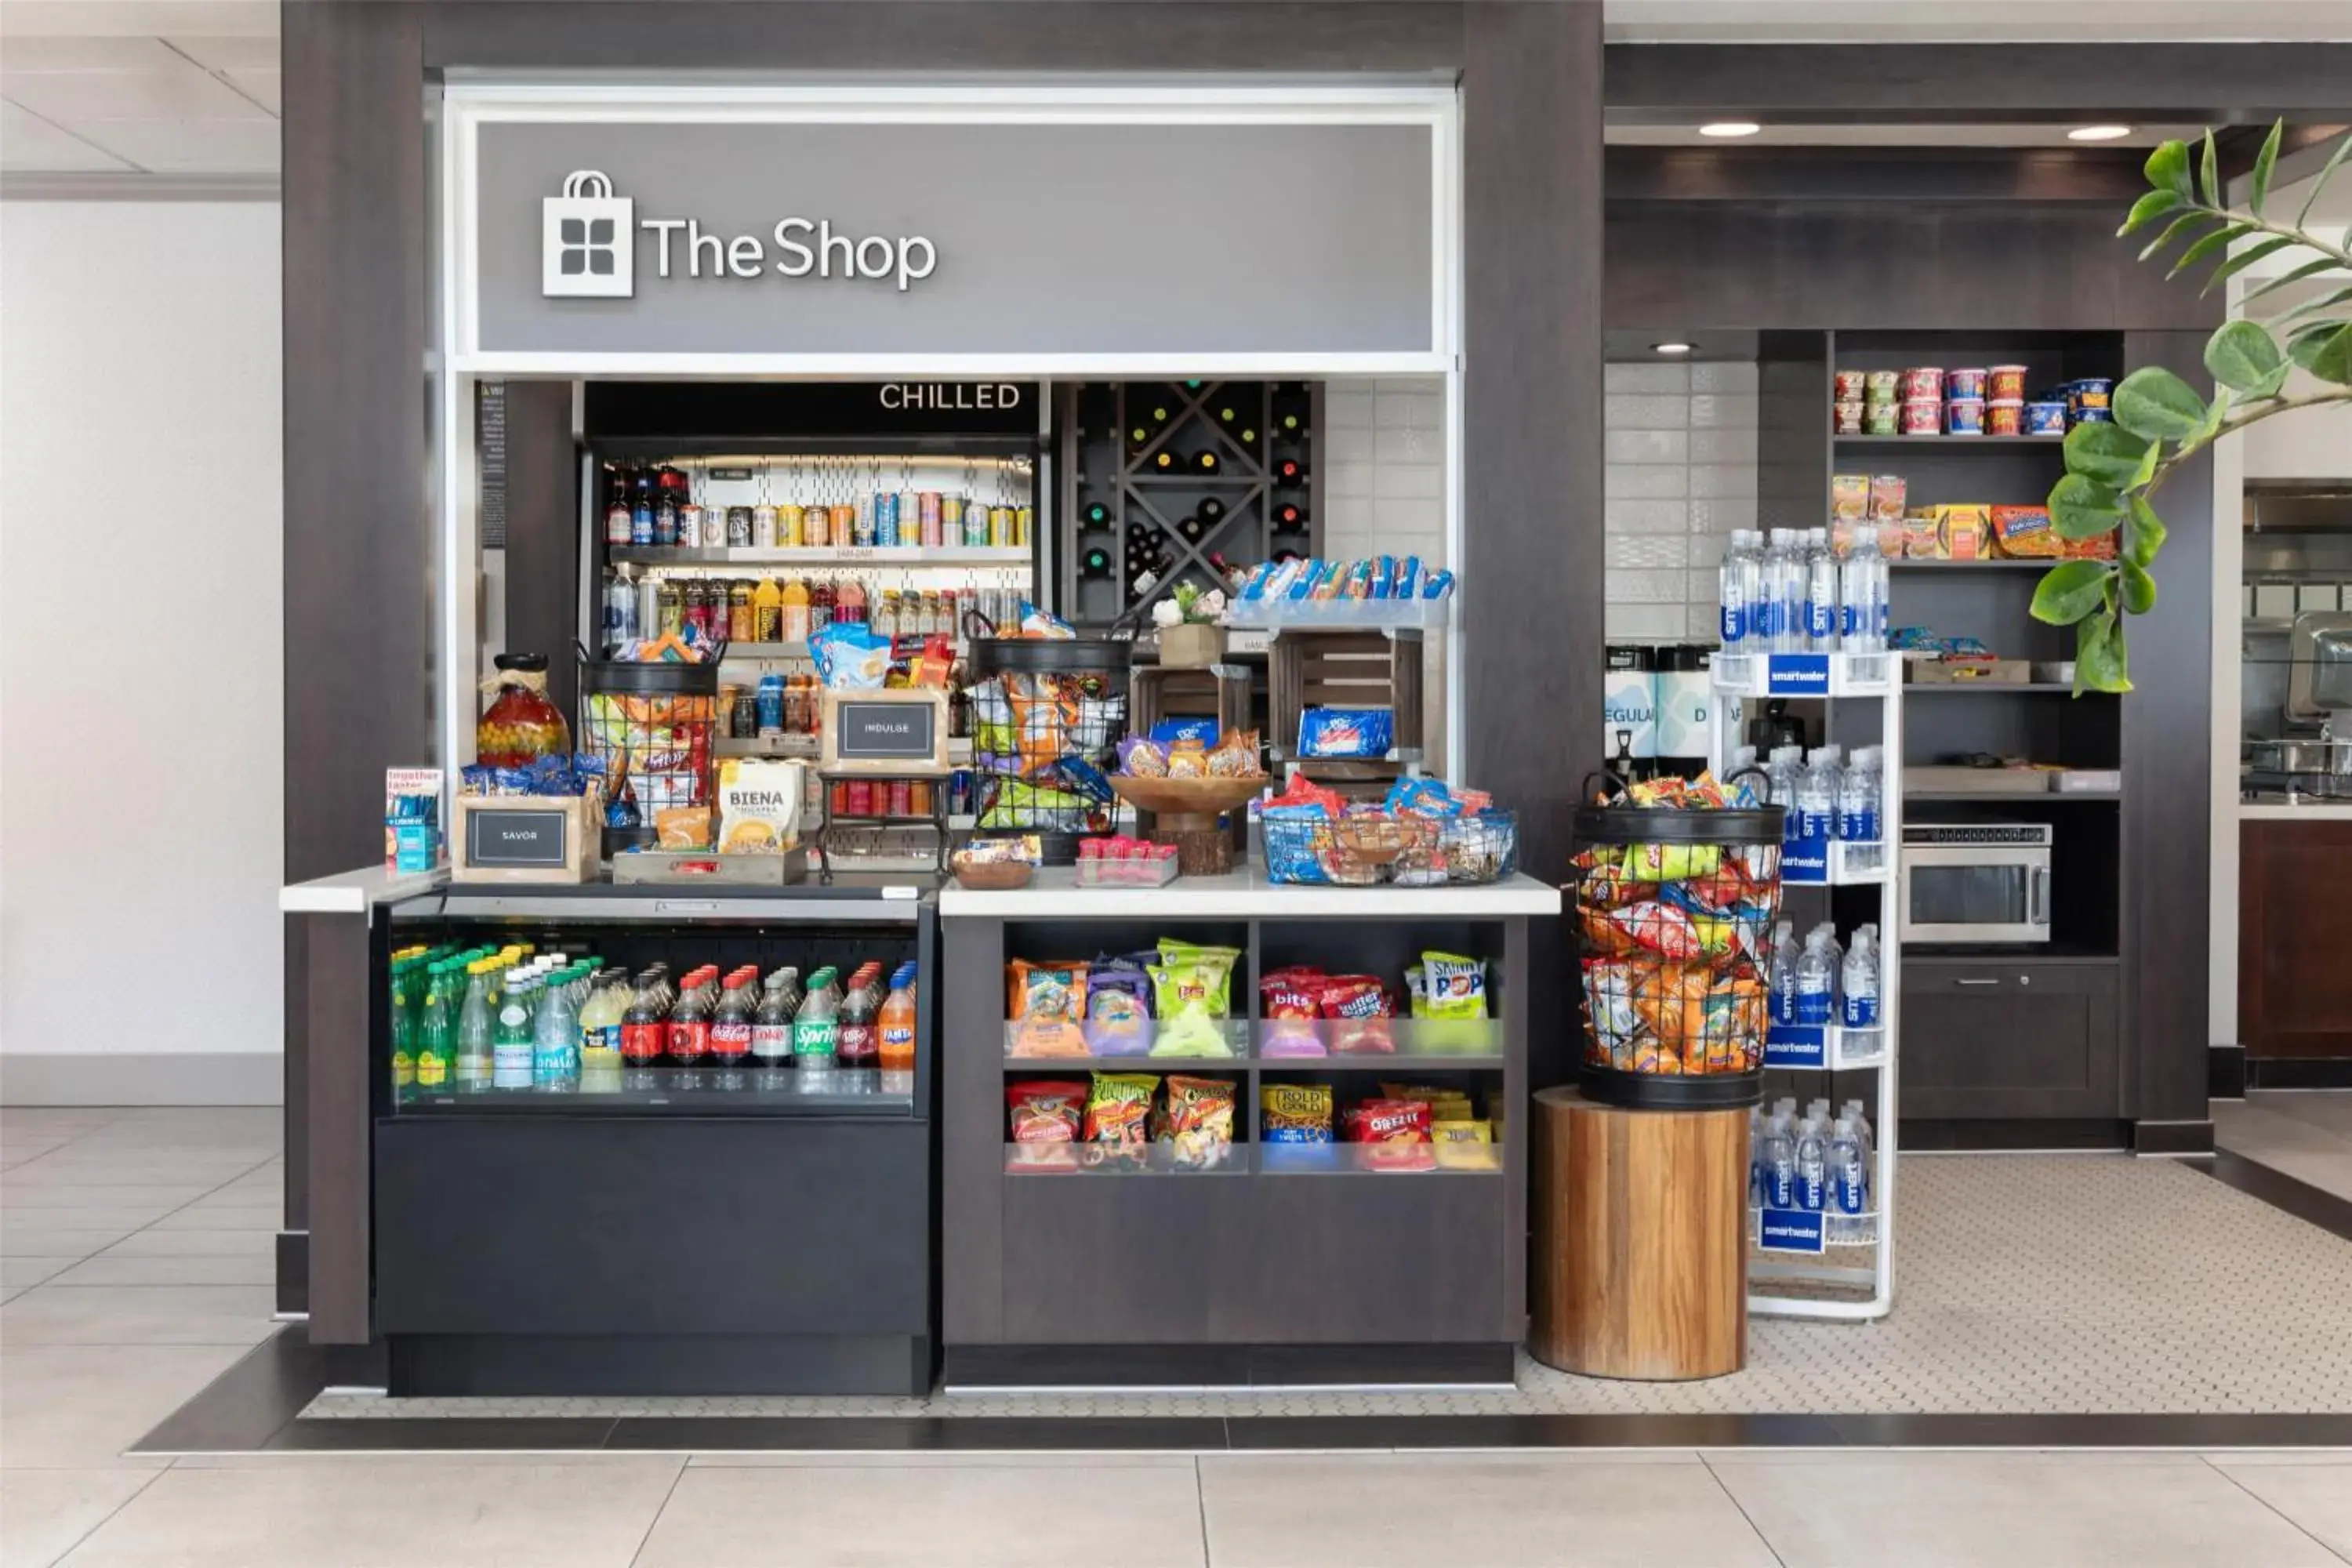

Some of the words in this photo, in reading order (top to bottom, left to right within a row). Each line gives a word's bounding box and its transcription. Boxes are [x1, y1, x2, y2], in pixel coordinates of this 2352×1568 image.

[641, 219, 764, 278] The
[773, 217, 937, 292] Shop
[879, 383, 1020, 409] CHILLED
[1771, 670, 1827, 681] smartwater
[865, 724, 910, 733] INDULGE
[730, 792, 783, 807] BIENA
[503, 831, 538, 840] SAVOR
[1274, 993, 1309, 1007] bits
[1783, 975, 1795, 1020] smart
[1766, 1044, 1820, 1054] smartwater
[1779, 1160, 1789, 1205] smart
[1809, 1161, 1819, 1207] smart
[1848, 1161, 1858, 1208] smart
[1765, 1225, 1819, 1239] smartwater
